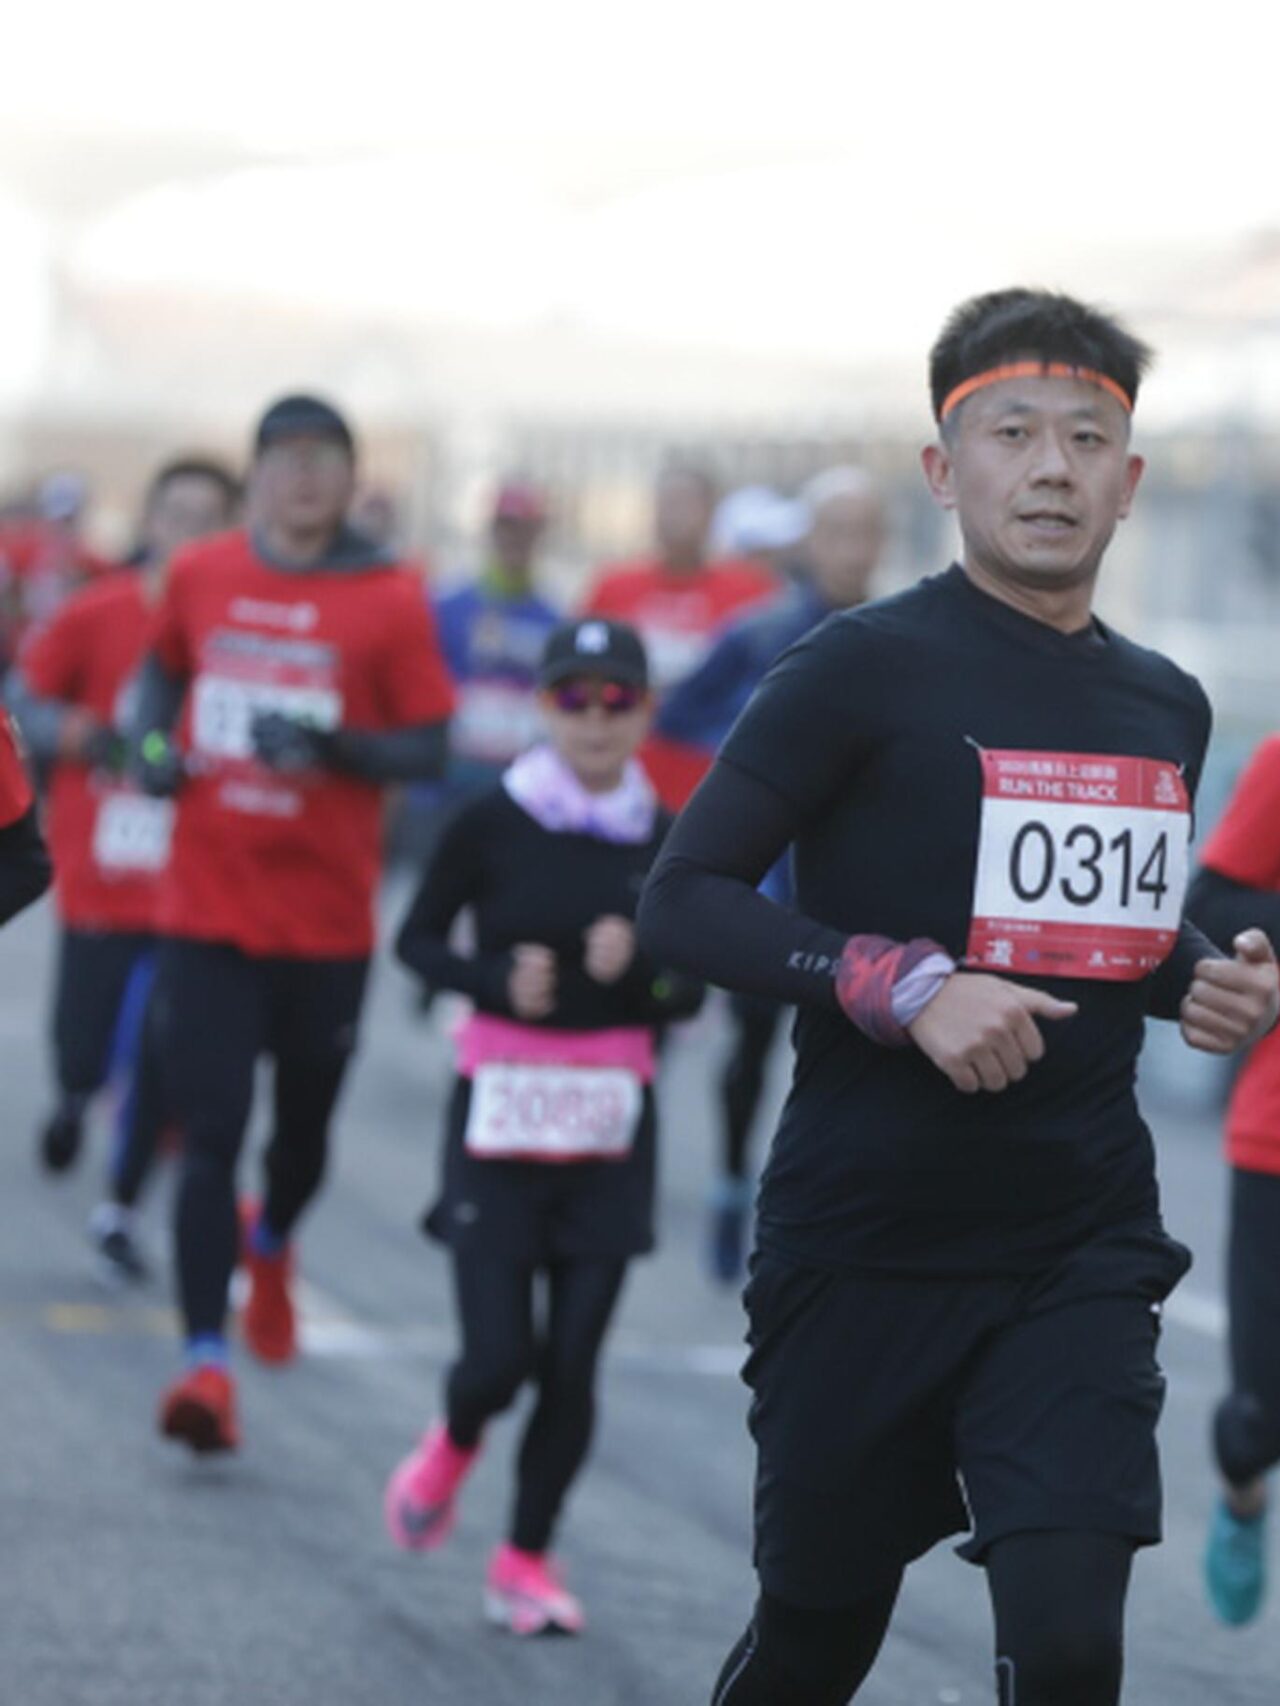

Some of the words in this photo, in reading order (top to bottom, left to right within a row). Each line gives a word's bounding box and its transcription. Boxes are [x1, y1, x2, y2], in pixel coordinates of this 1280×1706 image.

[999, 777, 1032, 795] RUN
[1037, 780, 1064, 798] THE
[1066, 782, 1118, 801] TRACK
[1009, 820, 1168, 911] 0314
